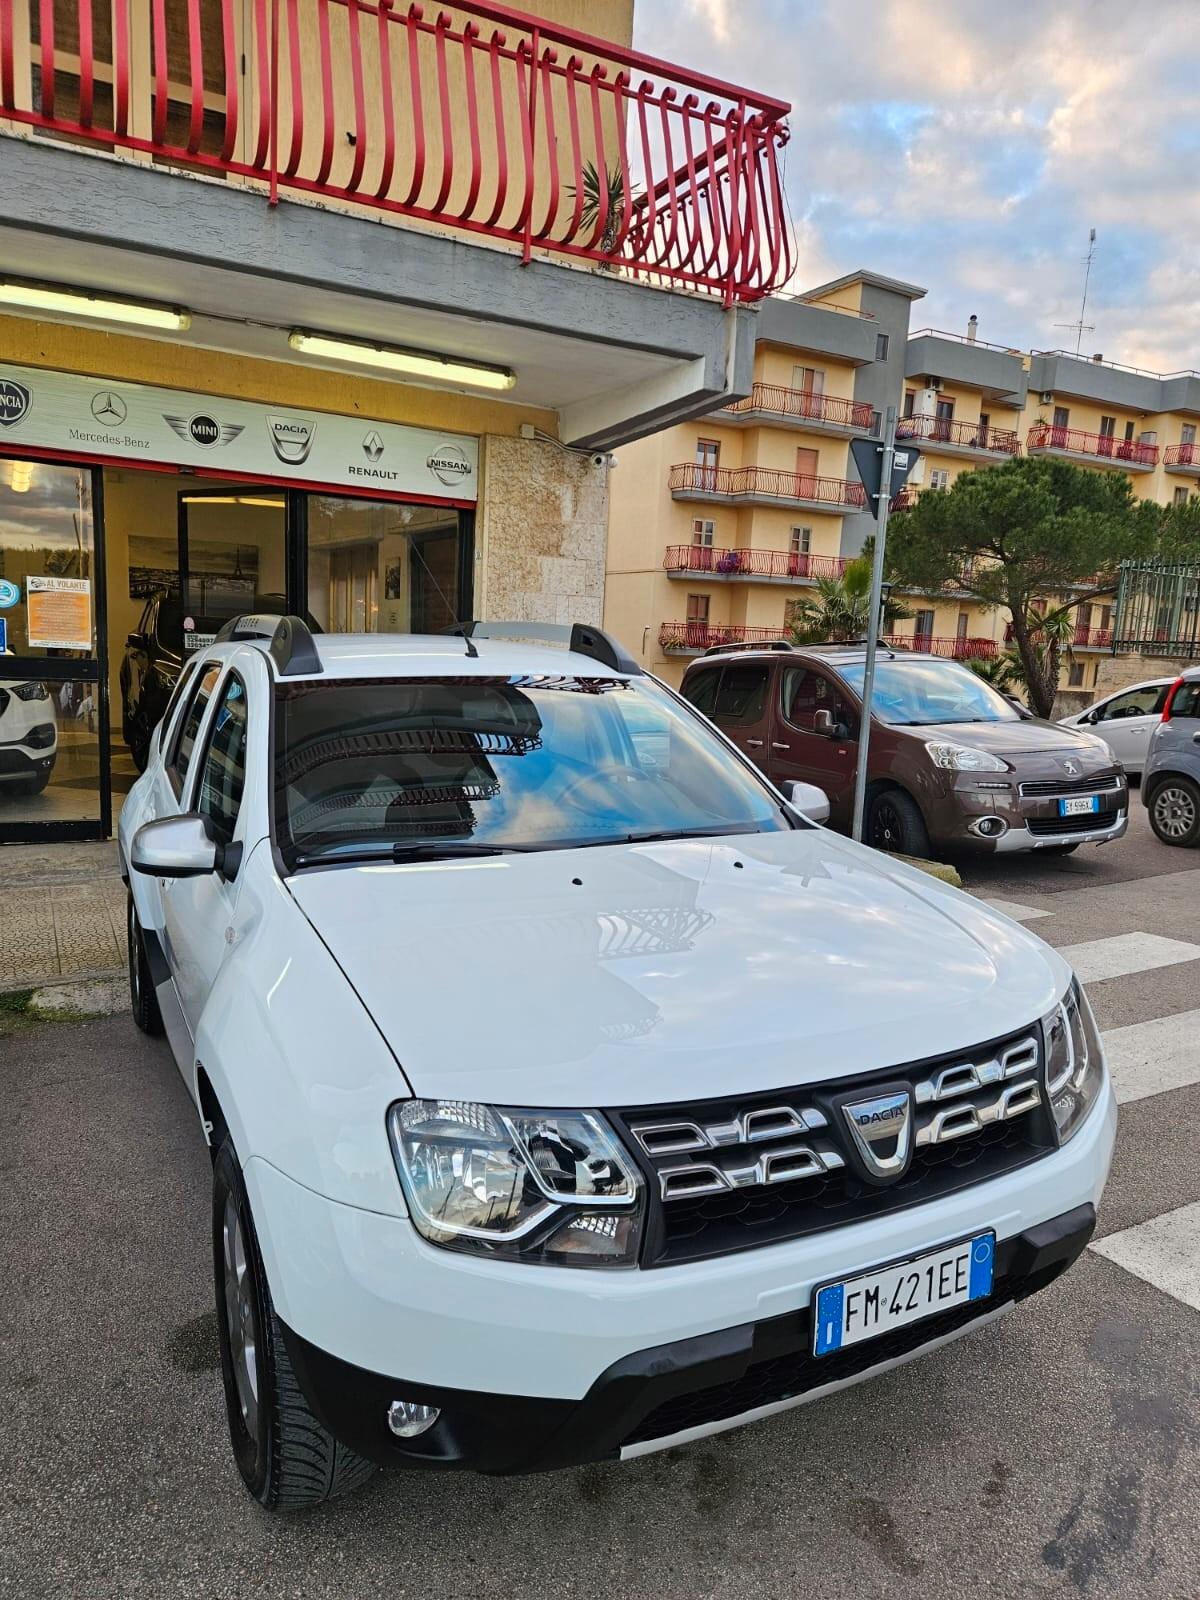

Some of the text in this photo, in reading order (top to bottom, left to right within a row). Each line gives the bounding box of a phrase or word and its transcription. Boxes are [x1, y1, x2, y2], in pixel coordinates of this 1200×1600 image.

[191, 424, 217, 437] MINI
[274, 423, 308, 435] DACIA
[69, 429, 150, 449] Mercedes-Benz
[430, 459, 468, 471] NISSAN
[348, 466, 399, 481] RENAULT
[860, 1106, 905, 1125] DACIA
[846, 1254, 969, 1332] FM 421EE
